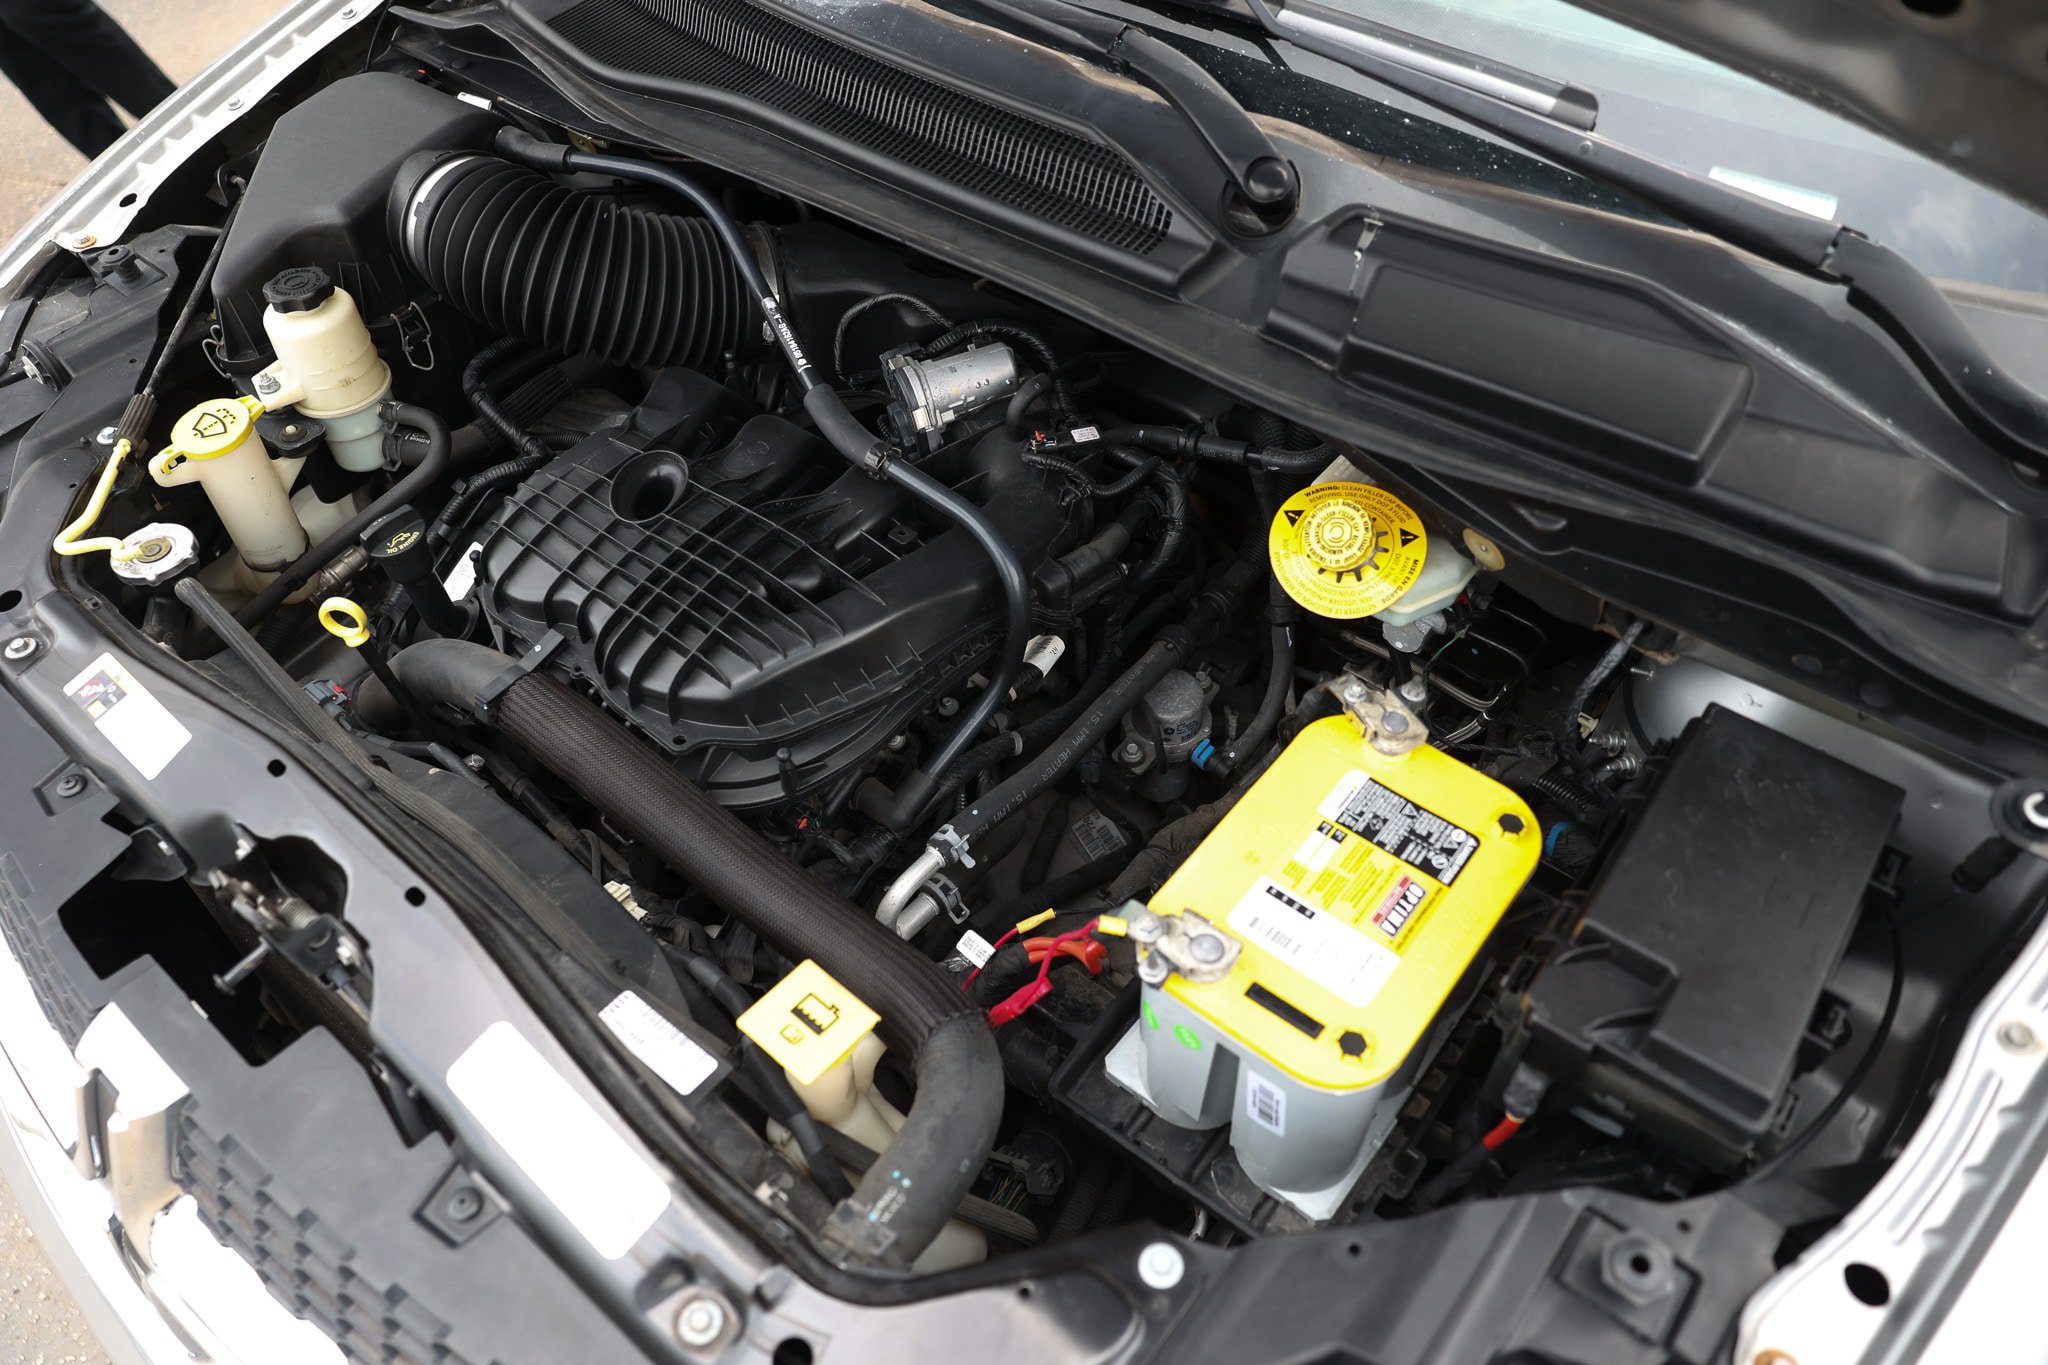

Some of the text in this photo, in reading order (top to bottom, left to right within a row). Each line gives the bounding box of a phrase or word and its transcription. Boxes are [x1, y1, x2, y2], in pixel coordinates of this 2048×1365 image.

[1304, 485, 1340, 497] WARNING:
[1364, 489, 1384, 499] FILLER
[1384, 497, 1397, 506] CAP
[1395, 504, 1413, 520] BEFORE
[1308, 491, 1342, 503] REMOVING.
[1359, 494, 1376, 502] ONLY
[1377, 500, 1389, 508] DOT
[1393, 510, 1406, 523] FLUID
[398, 532, 420, 550] ENGINE
[1393, 554, 1402, 566] DOT
[1409, 559, 1419, 575] MISE
[1381, 586, 1403, 603] GARDE
[1402, 576, 1410, 585] EN
[1114, 665, 1143, 697] HEATER
[1072, 710, 1104, 746] 15.1MM
[1040, 748, 1072, 782] HEATER
[992, 790, 1028, 823] 15.1MM
[1380, 883, 1425, 936] OPTIMA
